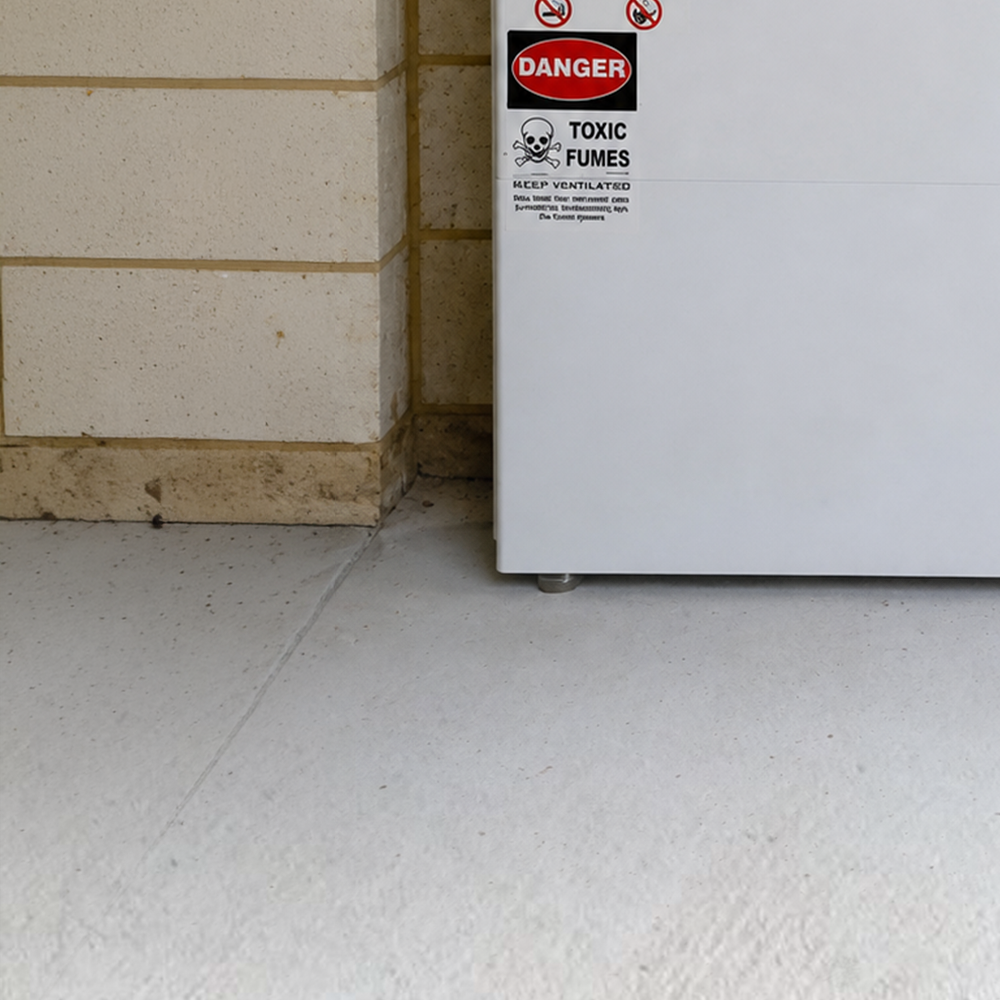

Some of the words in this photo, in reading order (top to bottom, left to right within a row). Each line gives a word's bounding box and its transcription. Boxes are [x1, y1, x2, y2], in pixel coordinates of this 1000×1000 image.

[518, 57, 626, 78] DANGER
[569, 121, 627, 140] TOXIC
[566, 149, 630, 168] FUMES
[552, 181, 631, 191] VENTILATED
